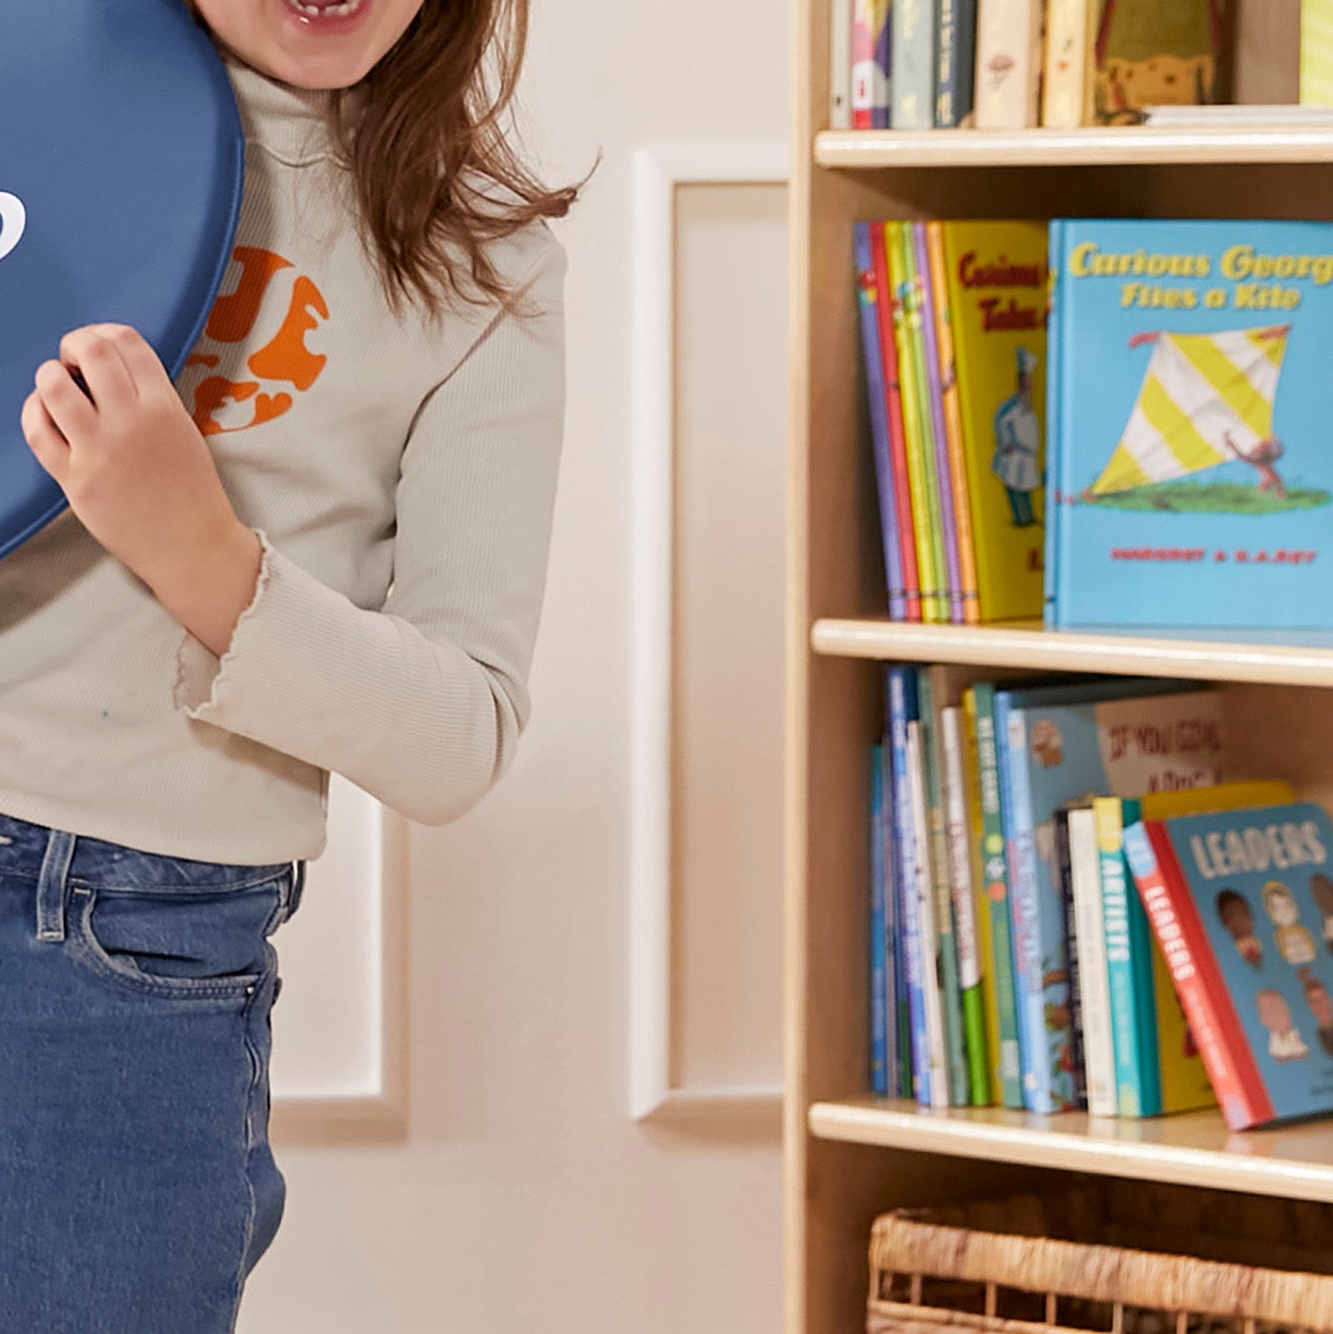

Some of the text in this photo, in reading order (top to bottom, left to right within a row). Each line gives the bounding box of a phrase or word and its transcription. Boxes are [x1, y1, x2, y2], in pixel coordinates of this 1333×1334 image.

[1069, 241, 1210, 278] Curious
[1120, 282, 1302, 310] Flies a Kite
[1190, 821, 1327, 880] LEADERS
[1101, 857, 1131, 962] ARTISTS
[1144, 885, 1196, 982] LEADERS
